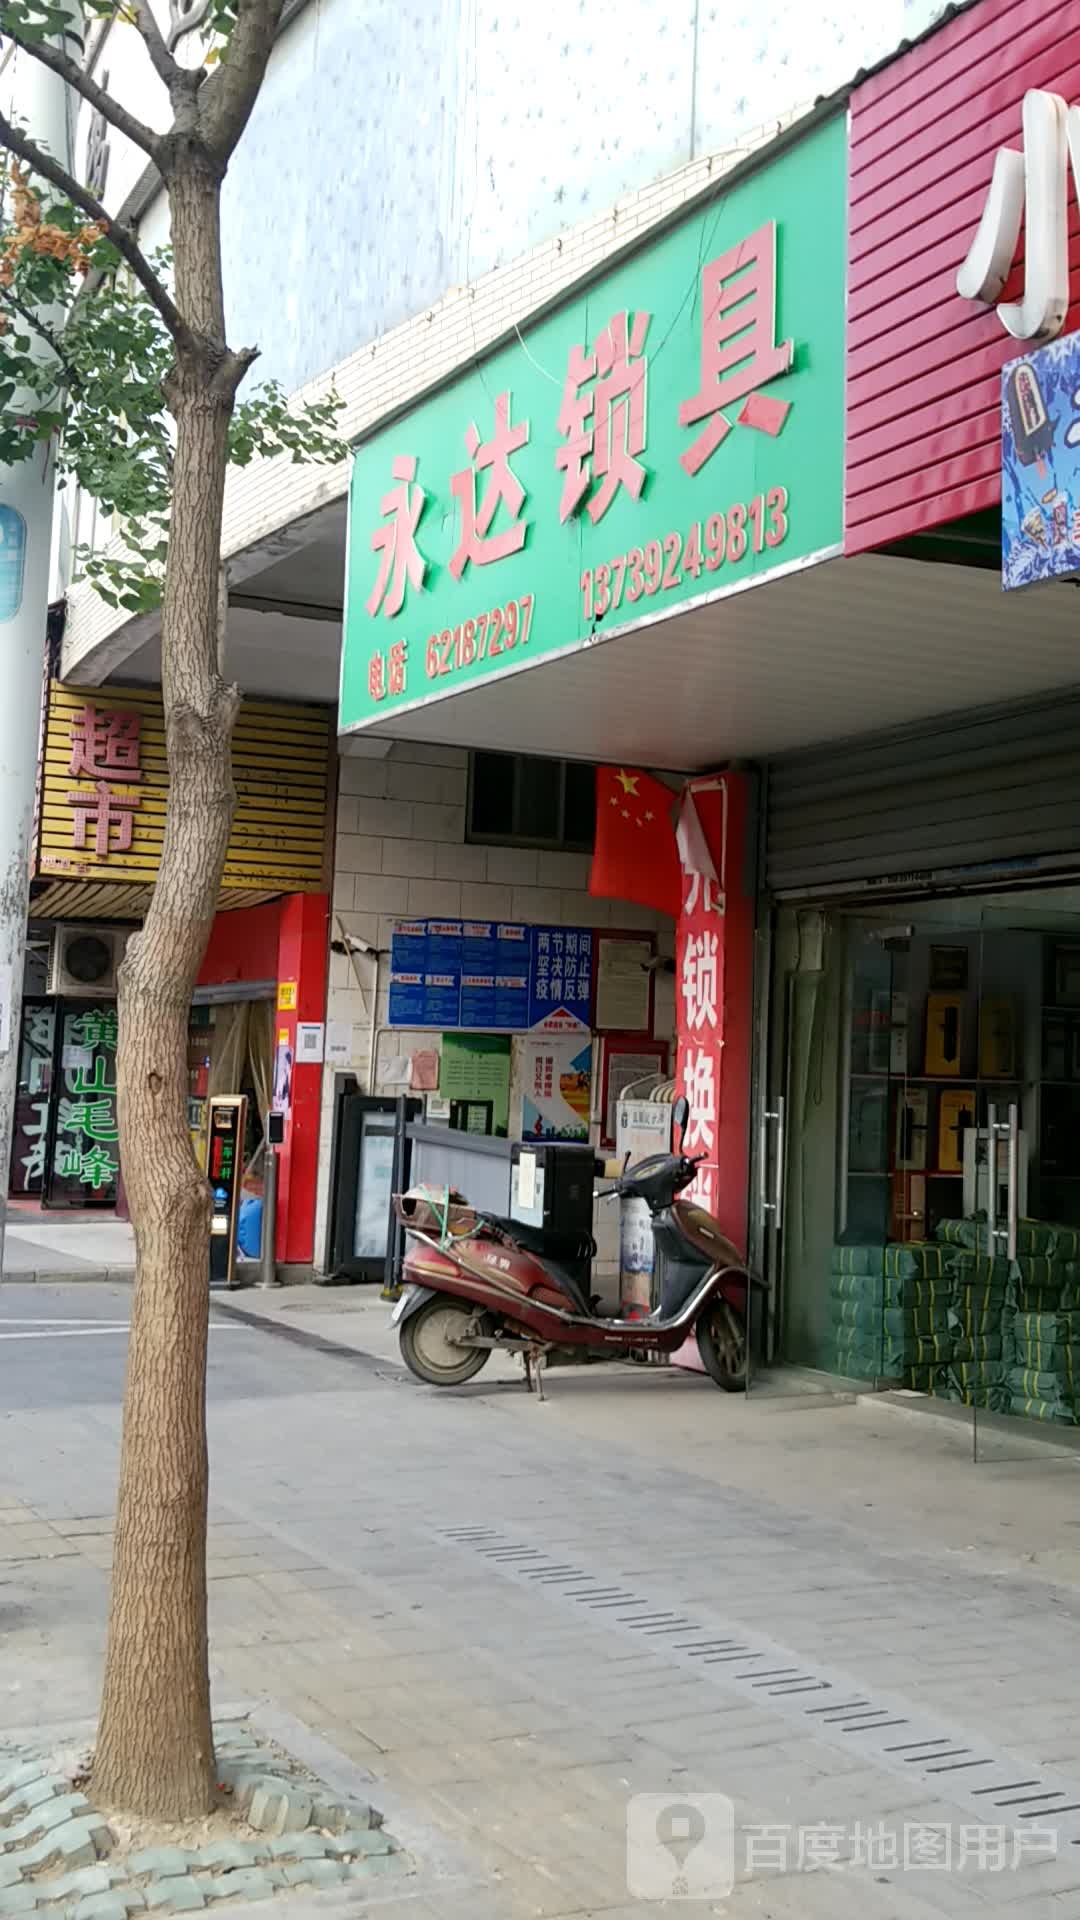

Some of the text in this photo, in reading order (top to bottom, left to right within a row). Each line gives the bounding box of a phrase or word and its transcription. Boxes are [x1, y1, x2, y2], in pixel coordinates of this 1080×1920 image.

[366, 219, 796, 617] 永达锁具
[368, 486, 788, 701] 电话 62187297 13739249813
[66, 703, 144, 858] 超市
[535, 978, 590, 1001] 疫情反弹
[536, 954, 591, 977] 坚决防止
[537, 932, 592, 955] 两节期间
[61, 1008, 120, 1190] 黄山毛峰
